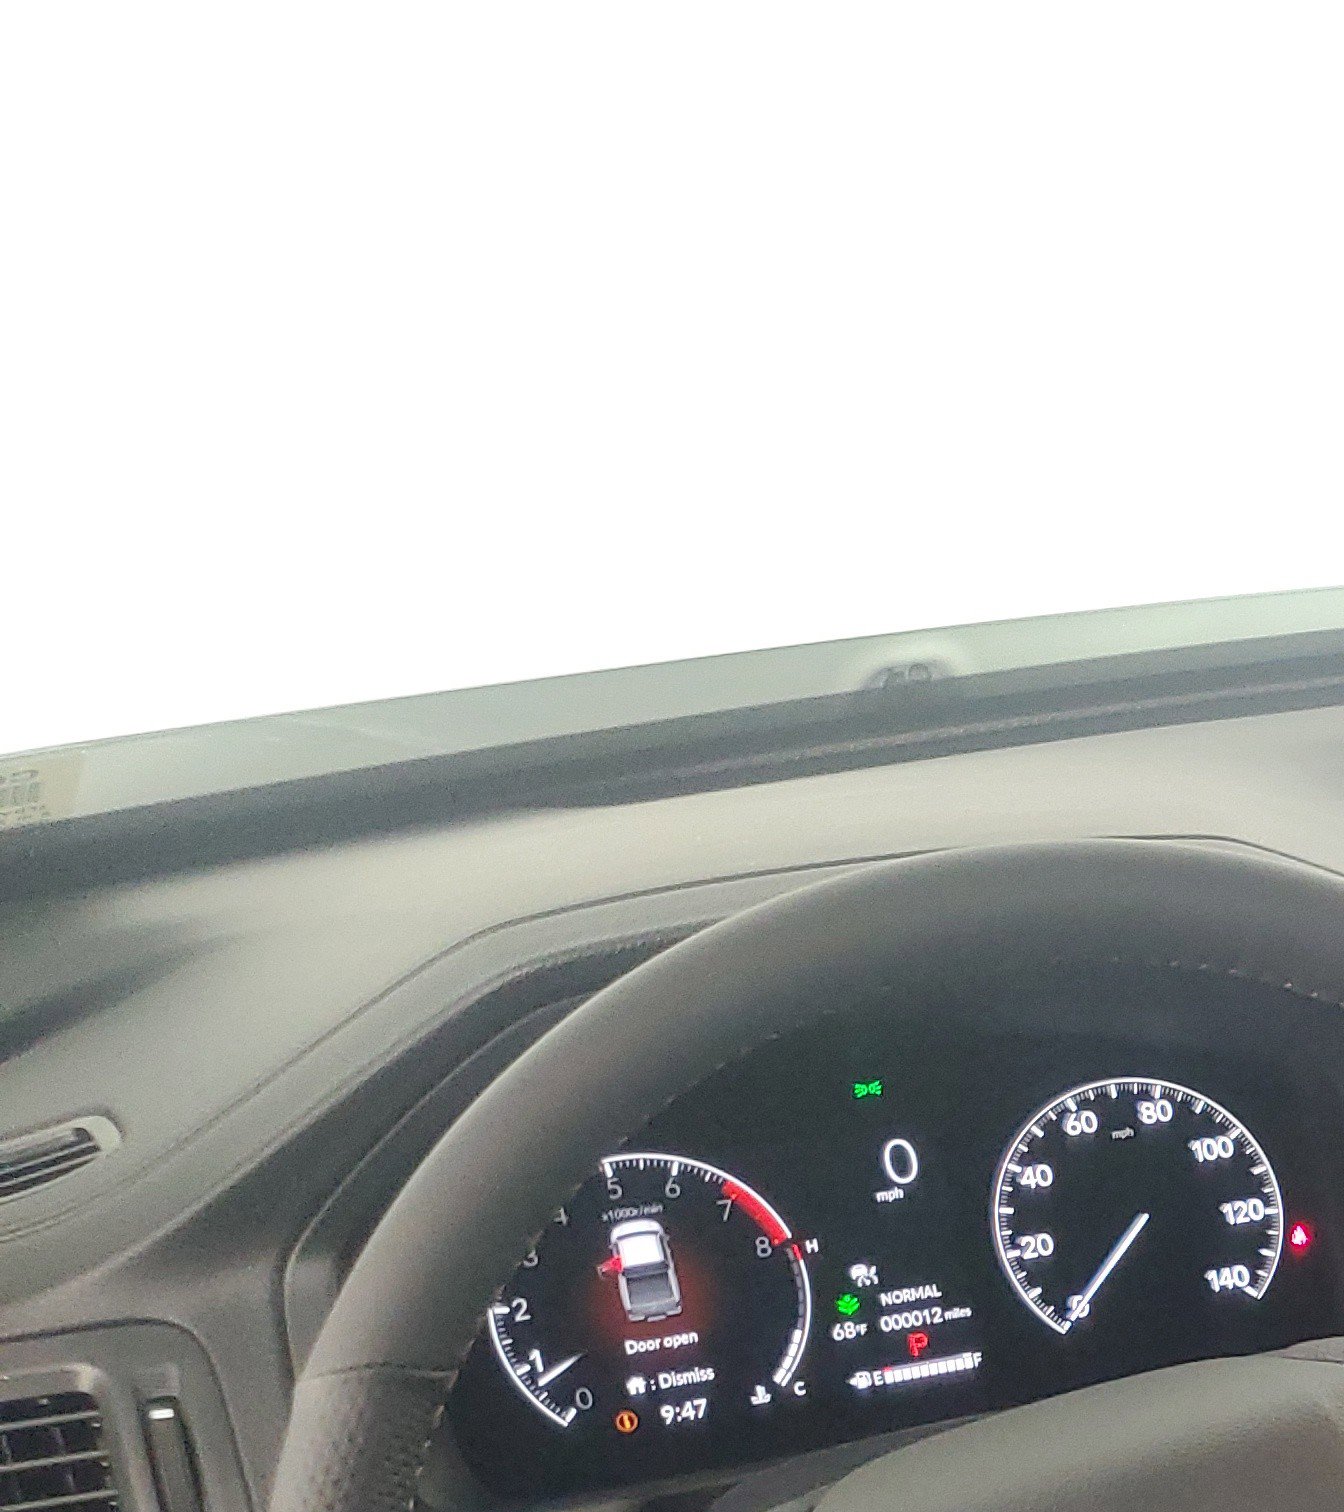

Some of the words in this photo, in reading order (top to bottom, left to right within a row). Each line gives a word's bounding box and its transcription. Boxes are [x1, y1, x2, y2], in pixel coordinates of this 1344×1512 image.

[1064, 1109, 1099, 1136] 60
[1137, 1099, 1173, 1127] 80
[1111, 1127, 1135, 1140] mph
[1190, 1134, 1235, 1162] 100
[883, 1138, 918, 1185] 0
[1018, 1163, 1054, 1189] 40
[607, 1179, 623, 1200] 5
[664, 1177, 681, 1199] 6
[876, 1187, 904, 1205] mph
[716, 1200, 733, 1222] 7
[1220, 1198, 1265, 1225] 120
[755, 1236, 773, 1259] 8
[805, 1238, 819, 1254] H
[1019, 1232, 1055, 1259] 20
[1206, 1264, 1250, 1291] 140
[880, 1284, 942, 1307] NORMAL
[511, 1298, 531, 1323] 2
[880, 1307, 943, 1332] 000012
[944, 1307, 972, 1321] miles
[624, 1336, 661, 1356] Door
[663, 1331, 699, 1352] open
[907, 1332, 929, 1357] P
[529, 1350, 544, 1372] 1
[973, 1351, 983, 1368] F
[658, 1367, 715, 1389] Dismiss
[793, 1381, 807, 1397] C
[873, 1370, 884, 1387] E
[575, 1387, 594, 1410] 0
[660, 1398, 708, 1426] 9:47
